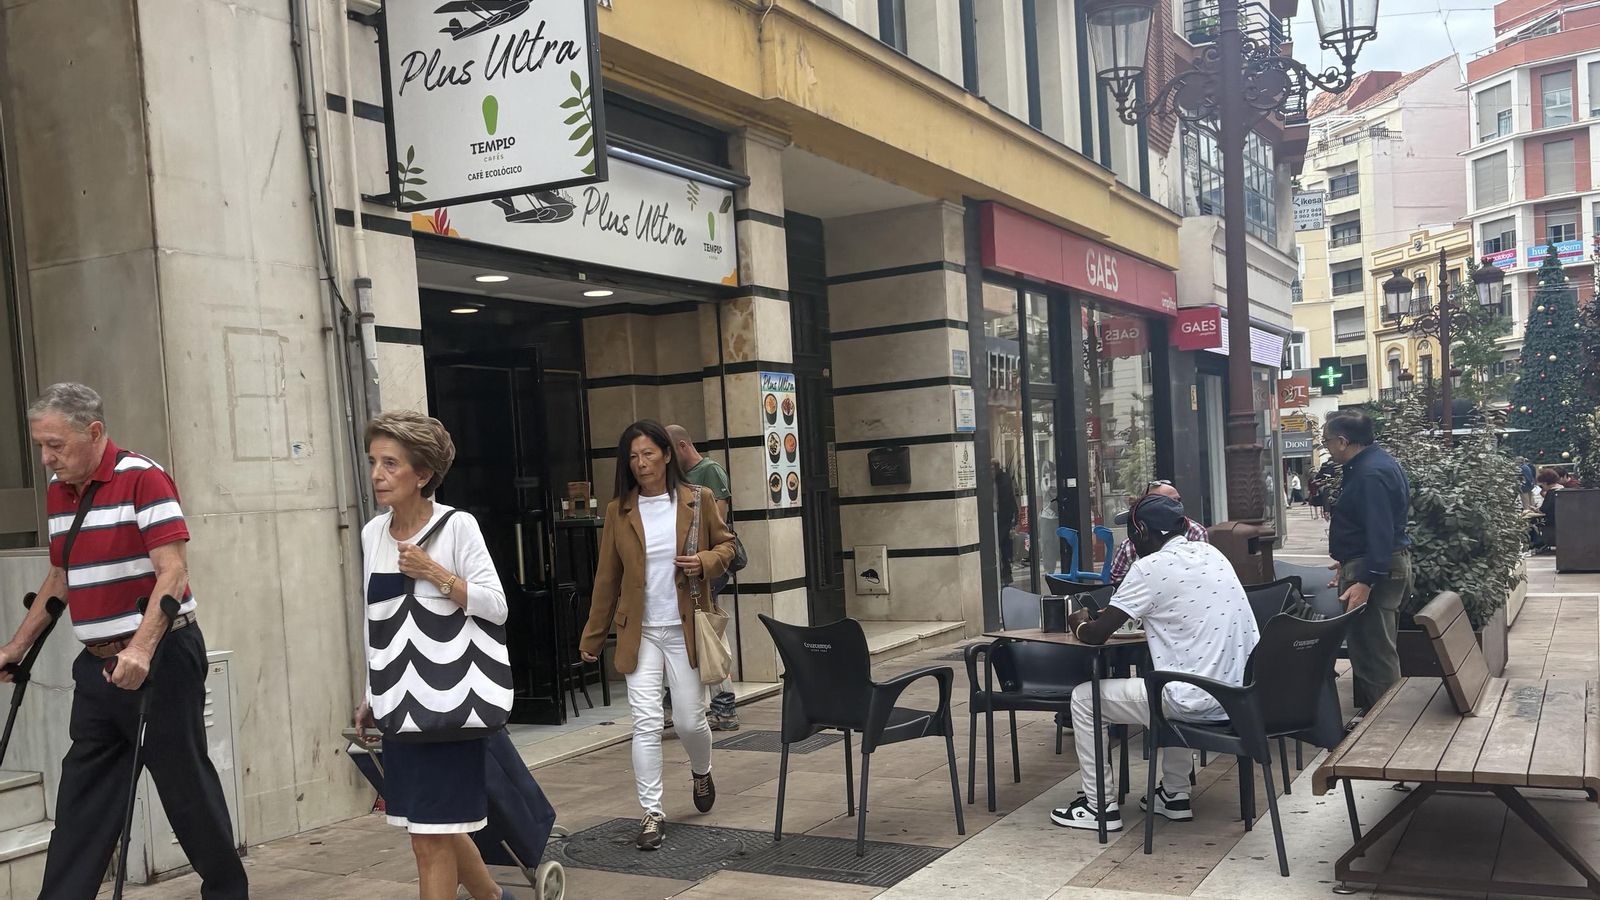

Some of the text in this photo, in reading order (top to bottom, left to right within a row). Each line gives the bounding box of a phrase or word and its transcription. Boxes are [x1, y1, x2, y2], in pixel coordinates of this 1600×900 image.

[398, 20, 581, 96] Plus Ultra
[470, 136, 516, 155] TEMPLO
[467, 165, 522, 181] CAFÉ ECOLÓGICO
[582, 186, 687, 246] Plus Ultra
[1086, 248, 1119, 293] GAES
[1181, 319, 1217, 334] GAES
